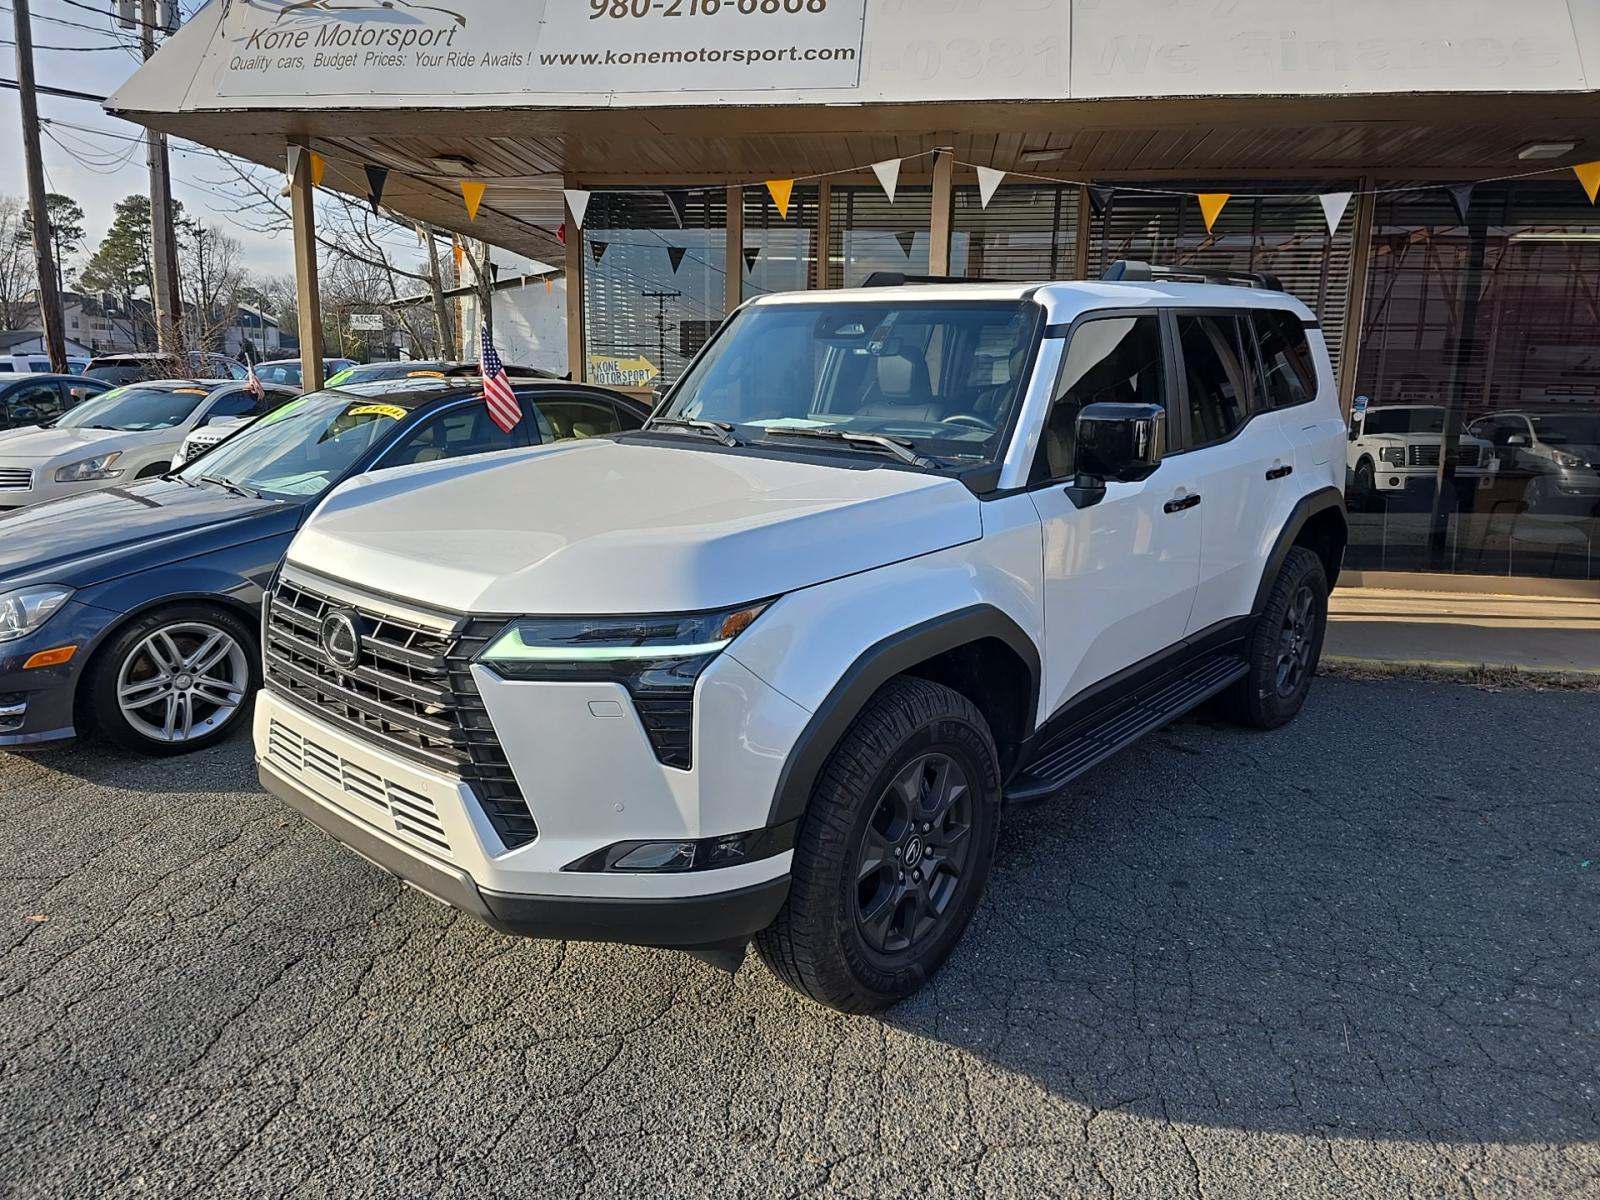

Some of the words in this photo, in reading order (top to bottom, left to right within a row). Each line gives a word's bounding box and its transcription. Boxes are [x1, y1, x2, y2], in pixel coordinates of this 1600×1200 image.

[245, 27, 309, 51] Kone
[314, 24, 458, 52] Motorsport
[230, 54, 271, 73] Quality
[314, 53, 357, 69] Budget
[415, 52, 448, 68] Your
[448, 51, 475, 67] Ride
[539, 46, 856, 66] www.konemotorsport.com
[594, 369, 650, 384] MOTORSPORT
[596, 361, 618, 373] KONE
